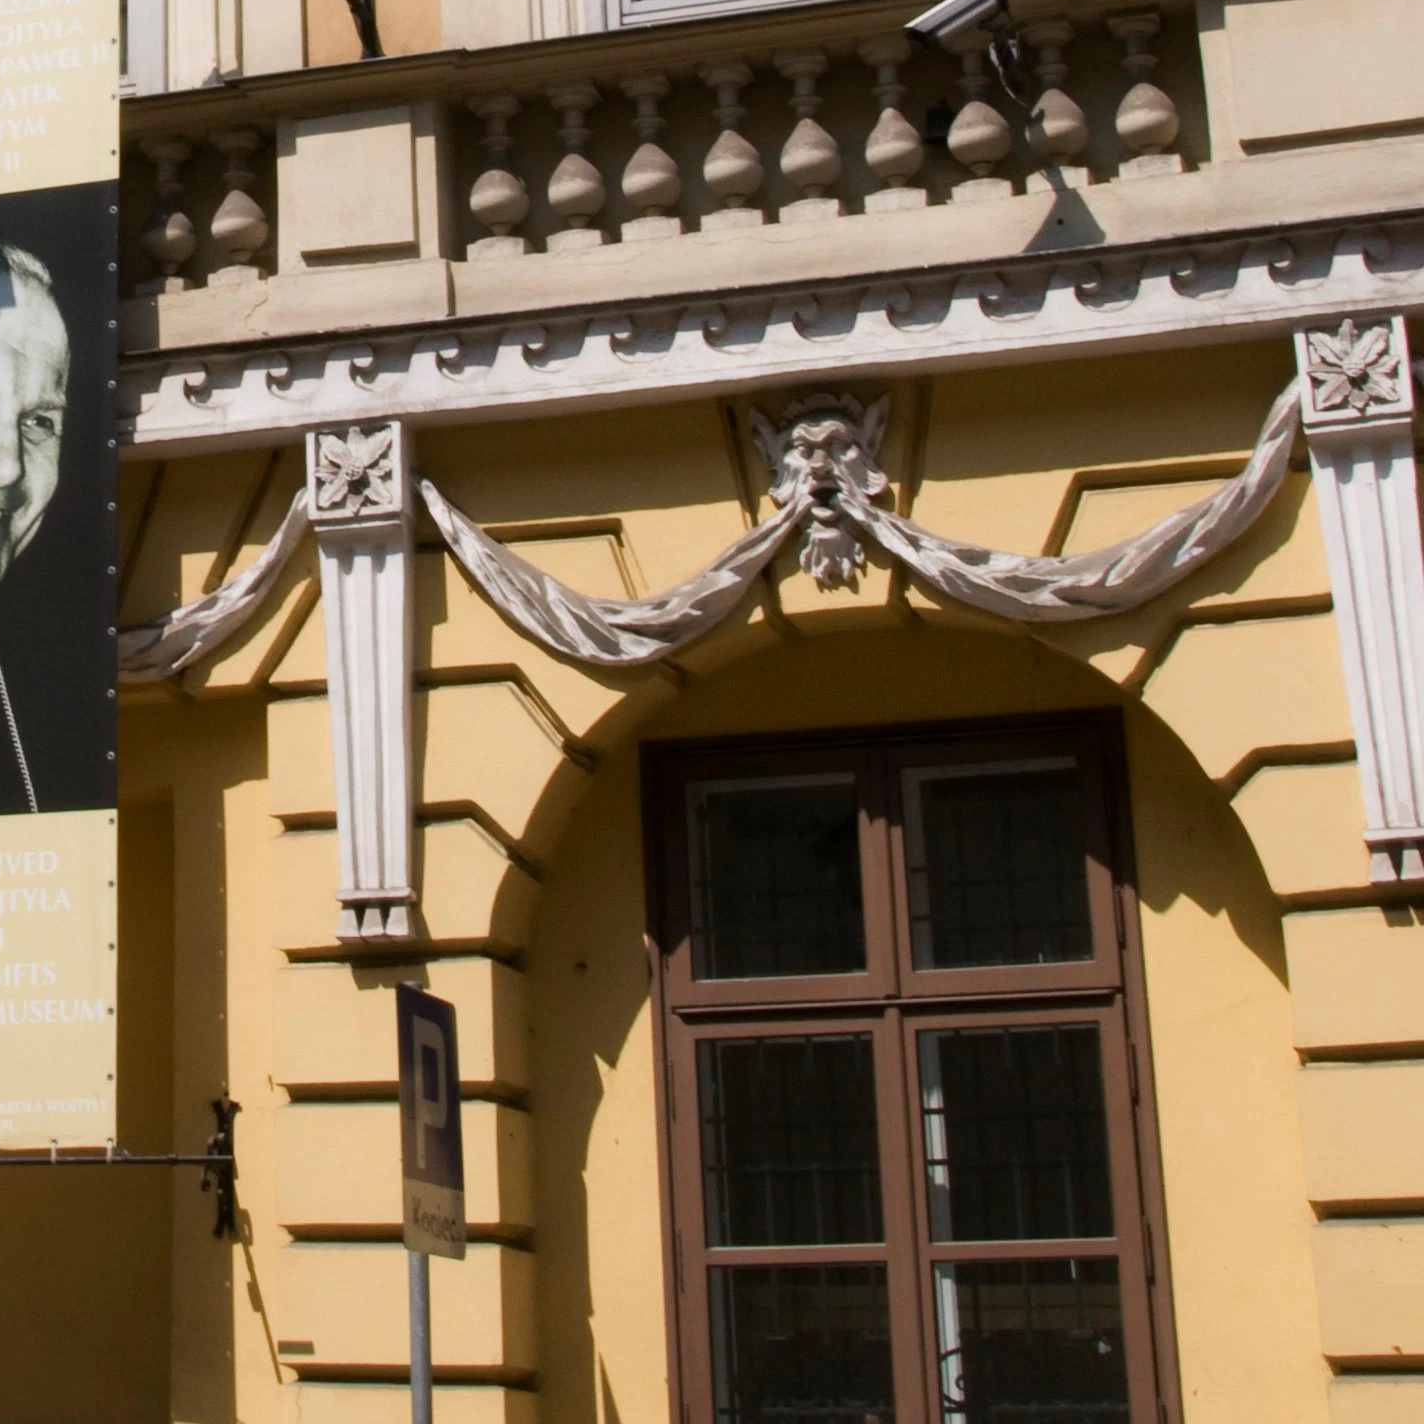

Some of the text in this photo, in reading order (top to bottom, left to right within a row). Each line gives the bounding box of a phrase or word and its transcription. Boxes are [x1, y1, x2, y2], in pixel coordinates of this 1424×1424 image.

[91, 44, 110, 65] II
[4, 150, 22, 173] II
[413, 1015, 448, 1170] P
[412, 1195, 457, 1243] Koniec
